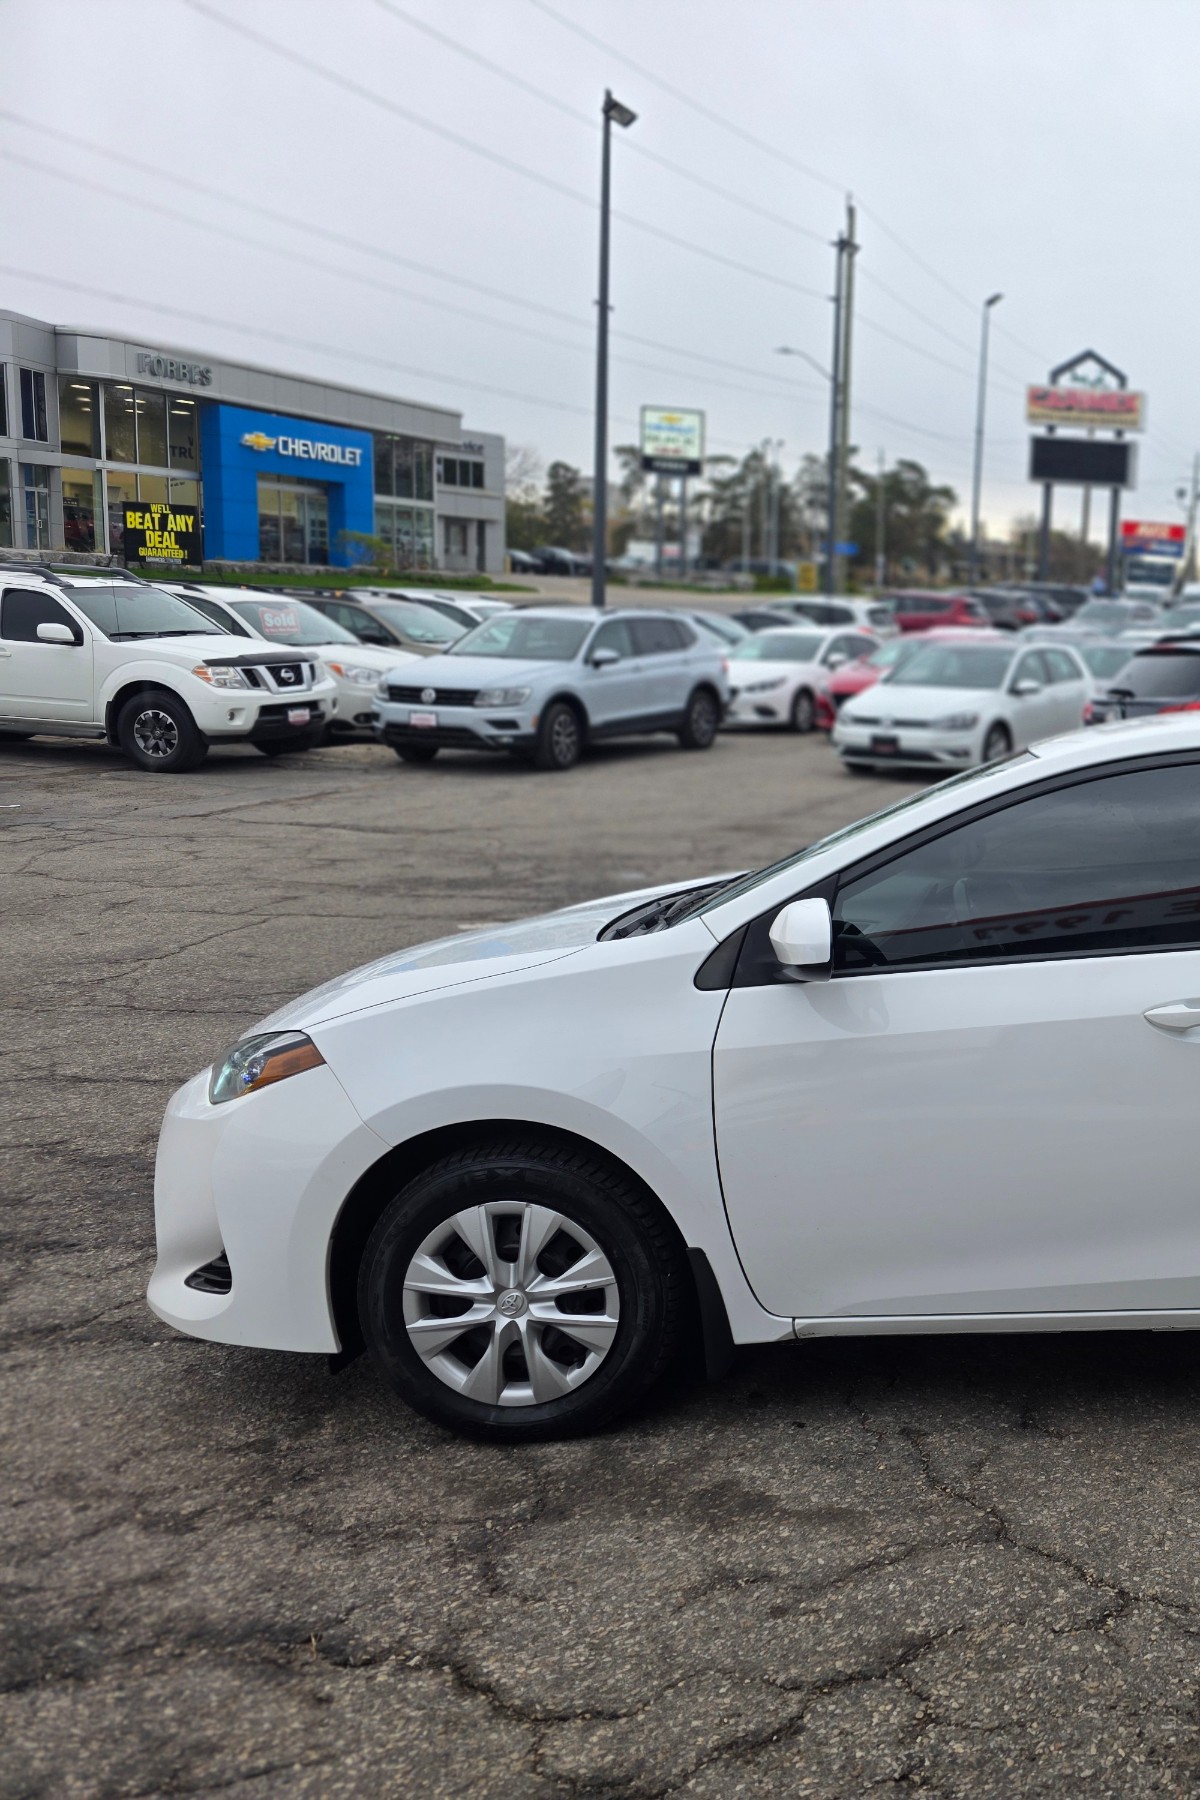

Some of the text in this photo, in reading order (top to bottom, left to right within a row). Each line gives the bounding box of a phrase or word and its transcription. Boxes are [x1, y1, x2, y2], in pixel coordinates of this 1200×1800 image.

[137, 352, 213, 386] FORBES
[277, 435, 363, 467] CHEVROLET
[126, 511, 194, 532] BEAT ANY
[145, 530, 179, 548] DEAL
[263, 613, 296, 627] Sold
